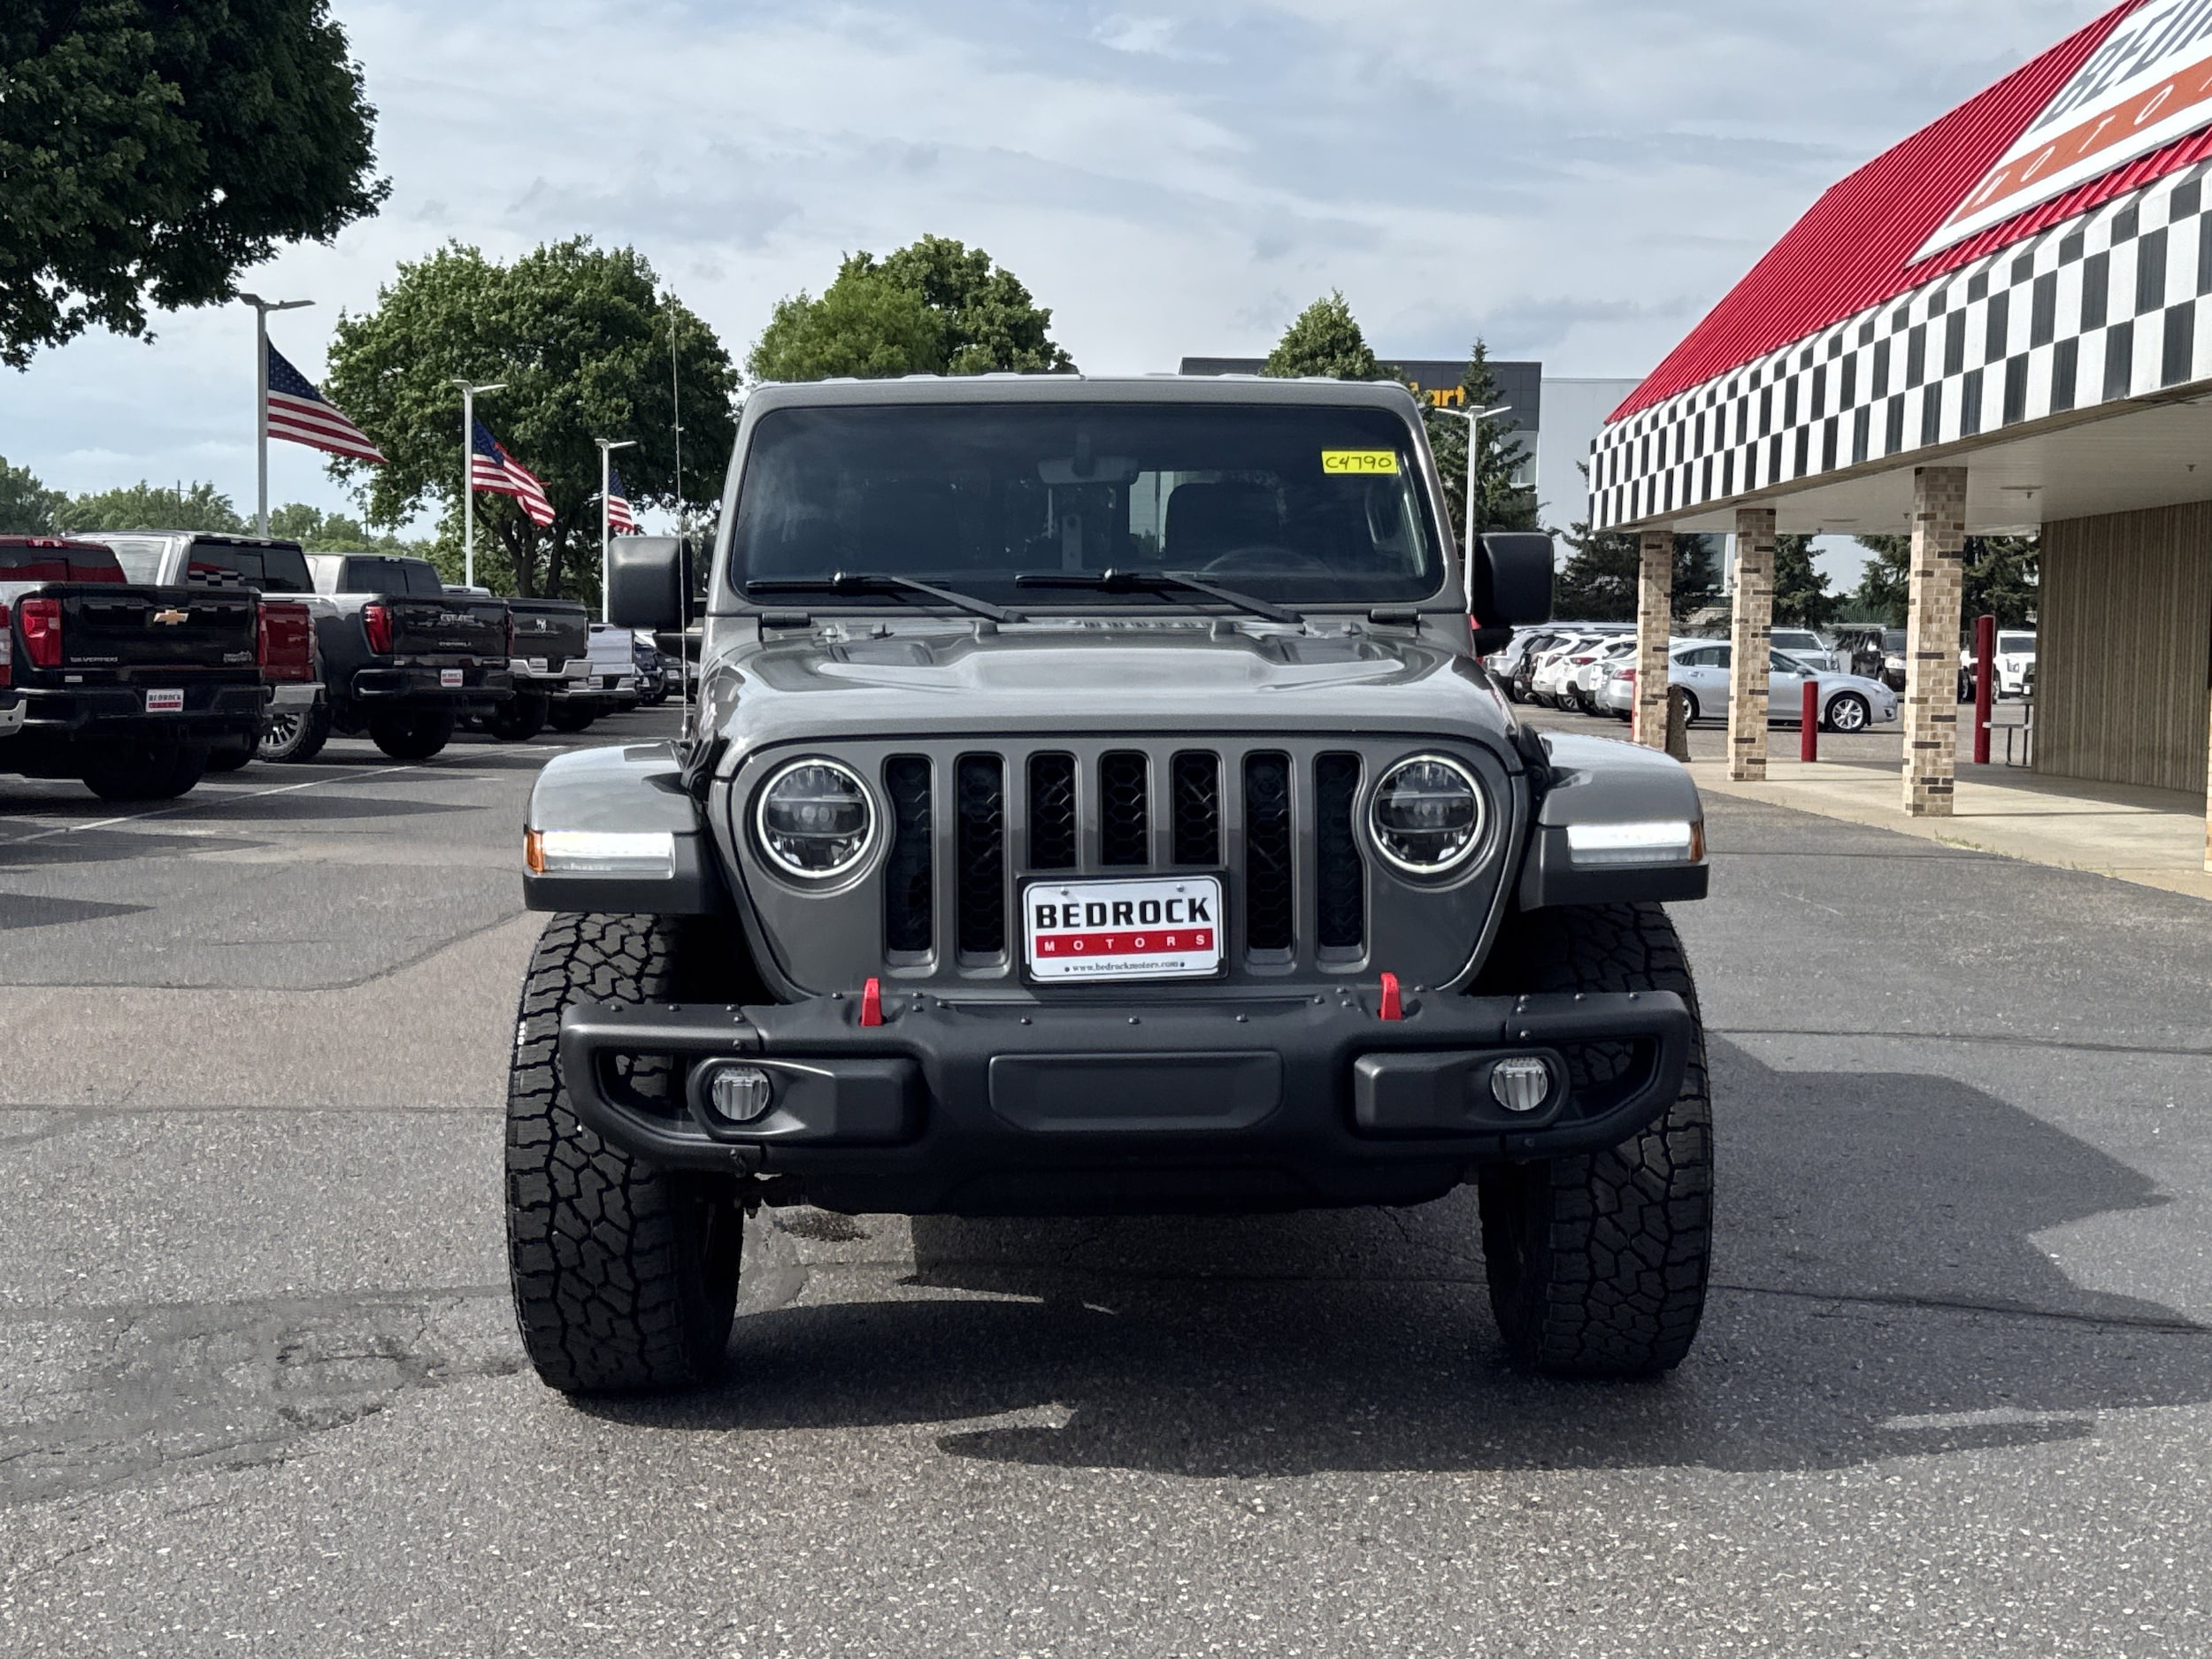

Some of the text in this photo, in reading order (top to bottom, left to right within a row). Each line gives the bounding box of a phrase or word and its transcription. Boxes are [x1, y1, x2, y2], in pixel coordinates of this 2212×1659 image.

[1325, 455, 1392, 471] C4790
[1035, 897, 1211, 929] BEDROCK
[1044, 934, 1206, 952] MOTORS
[1072, 961, 1179, 972] www.bedrockmotors.com
